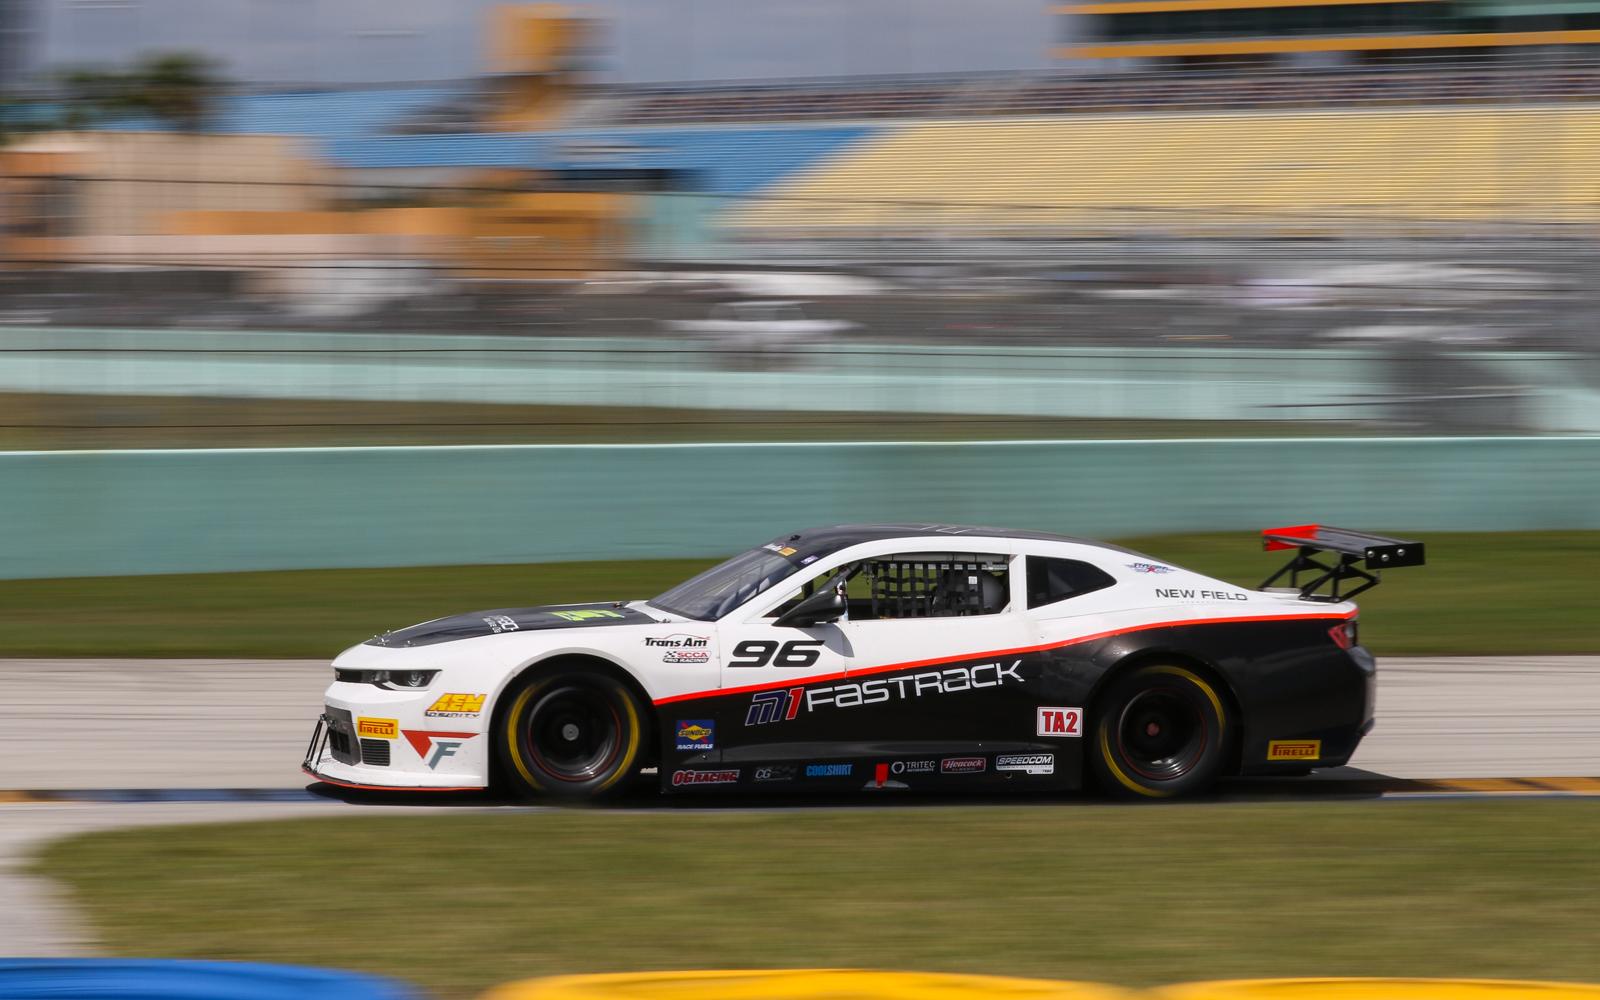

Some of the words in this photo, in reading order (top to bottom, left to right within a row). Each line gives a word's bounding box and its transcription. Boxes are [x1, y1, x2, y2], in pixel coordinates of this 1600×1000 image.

[1155, 589, 1195, 598] NEW
[1201, 590, 1248, 601] FIELD
[645, 637, 681, 647] Trans
[682, 637, 707, 647] Am
[727, 640, 825, 668] 96
[360, 720, 394, 735] PIRELLI
[1042, 711, 1078, 734] TA2
[678, 729, 712, 737] SUNOCO
[1272, 744, 1316, 756] PIRELLI
[906, 760, 935, 769] TRITEC
[998, 755, 1052, 765] SPEEDCOM
[806, 764, 853, 777] COOLSHIRT
